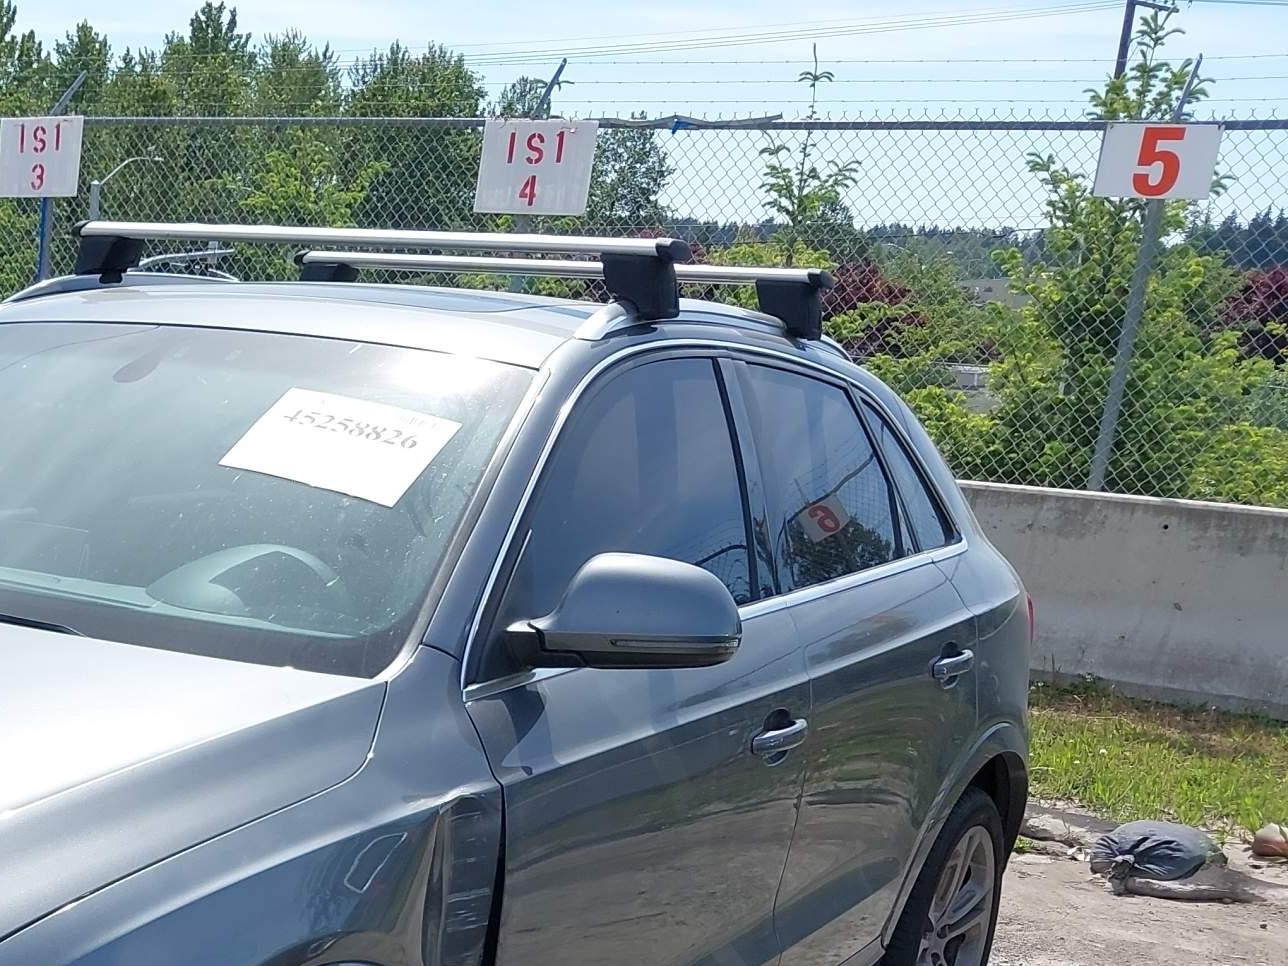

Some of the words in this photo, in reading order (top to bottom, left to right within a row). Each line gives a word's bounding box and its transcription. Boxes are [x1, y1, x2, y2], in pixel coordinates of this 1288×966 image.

[30, 163, 45, 191] 3
[1132, 126, 1187, 197] 5
[518, 174, 537, 207] 4
[283, 408, 419, 450] 45258826
